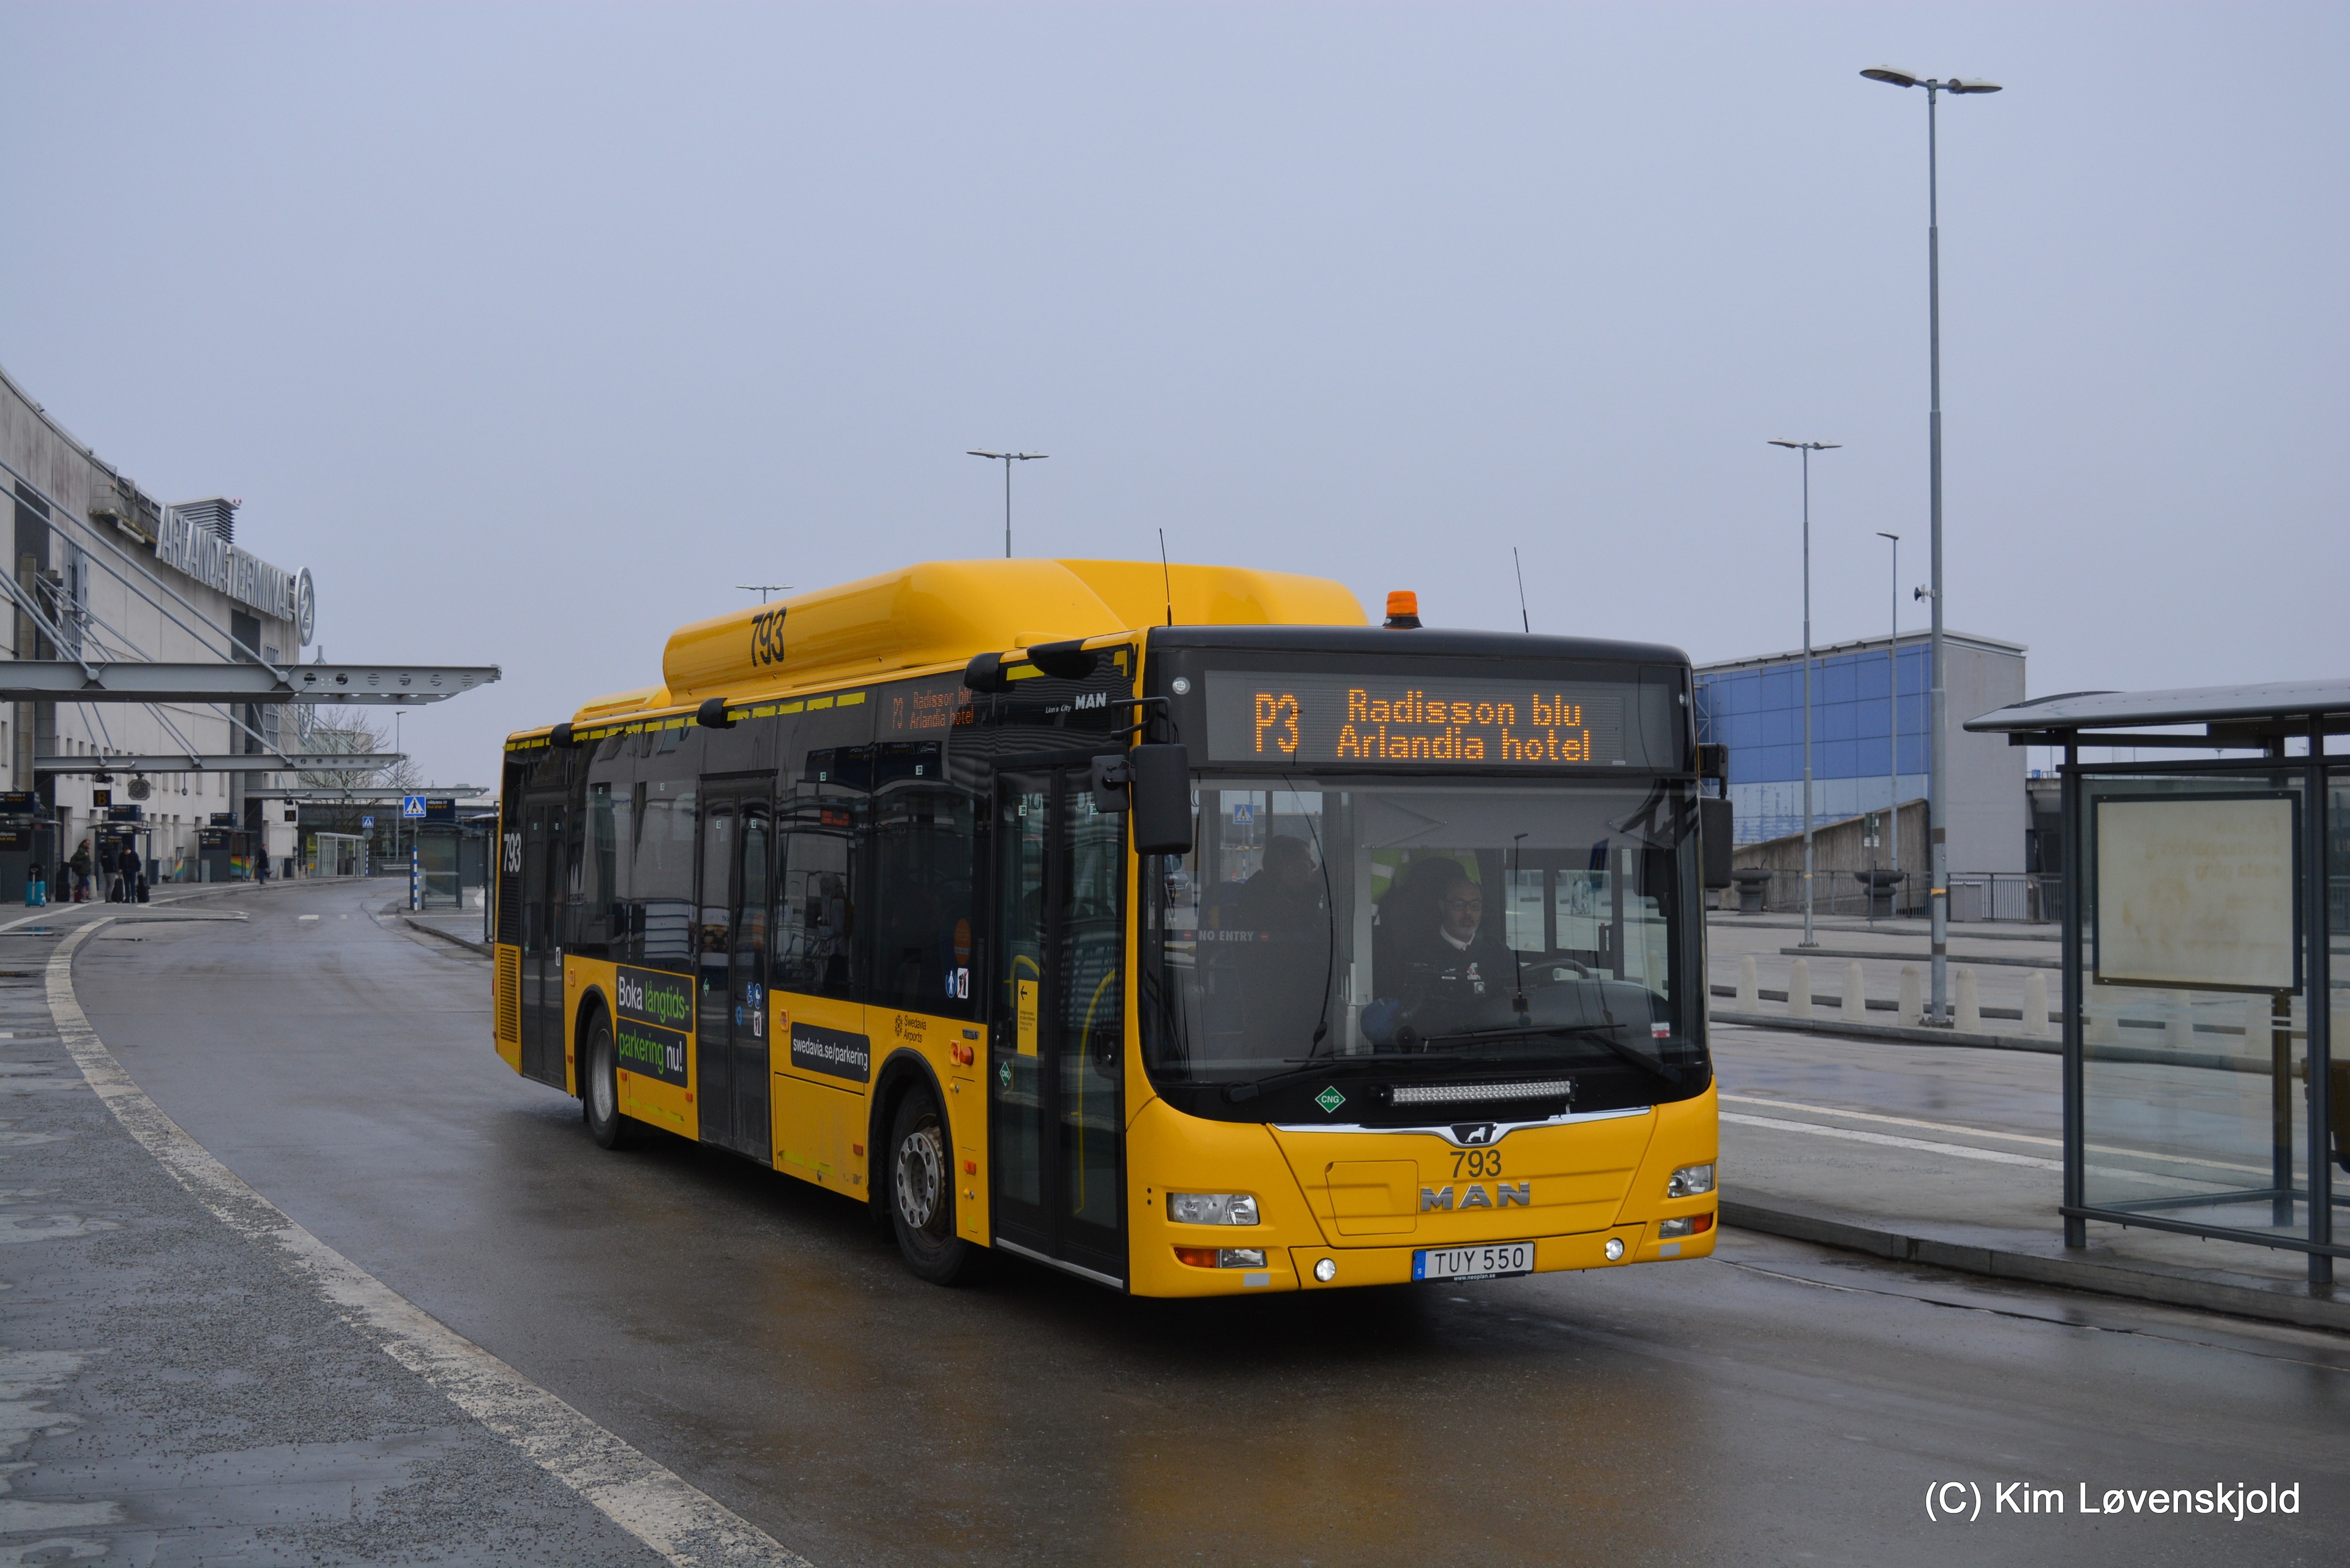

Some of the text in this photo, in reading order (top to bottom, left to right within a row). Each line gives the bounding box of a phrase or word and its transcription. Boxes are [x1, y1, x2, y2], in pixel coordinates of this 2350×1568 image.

[226, 544, 294, 622] TERMINAL
[751, 606, 787, 667] 793
[914, 689, 955, 709] Radisson
[1061, 704, 1072, 712] City
[1075, 692, 1106, 710] MAN
[1349, 689, 1581, 726] Radisson blu
[909, 704, 974, 729] Arlandia hotel
[1256, 693, 1298, 753] P3
[1337, 724, 1590, 761] Arlandia hotel
[97, 791, 107, 805] B
[286, 812, 294, 820] A
[504, 832, 521, 873] 793
[1199, 930, 1255, 941] NO ENTRY
[619, 976, 690, 1024] Boka långtids-
[903, 1029, 923, 1043] Airports
[904, 1014, 927, 1031] Swedavia
[619, 1029, 683, 1075] parkering nu!
[793, 1037, 868, 1072] swedavia.se/parkering
[1321, 1095, 1340, 1103] CNG
[1450, 1149, 1502, 1178] 793
[1420, 1181, 1530, 1211] MAN
[1434, 1250, 1475, 1274] TUY
[1483, 1247, 1524, 1270] 550
[1453, 1272, 1496, 1282] www.neoplan.se
